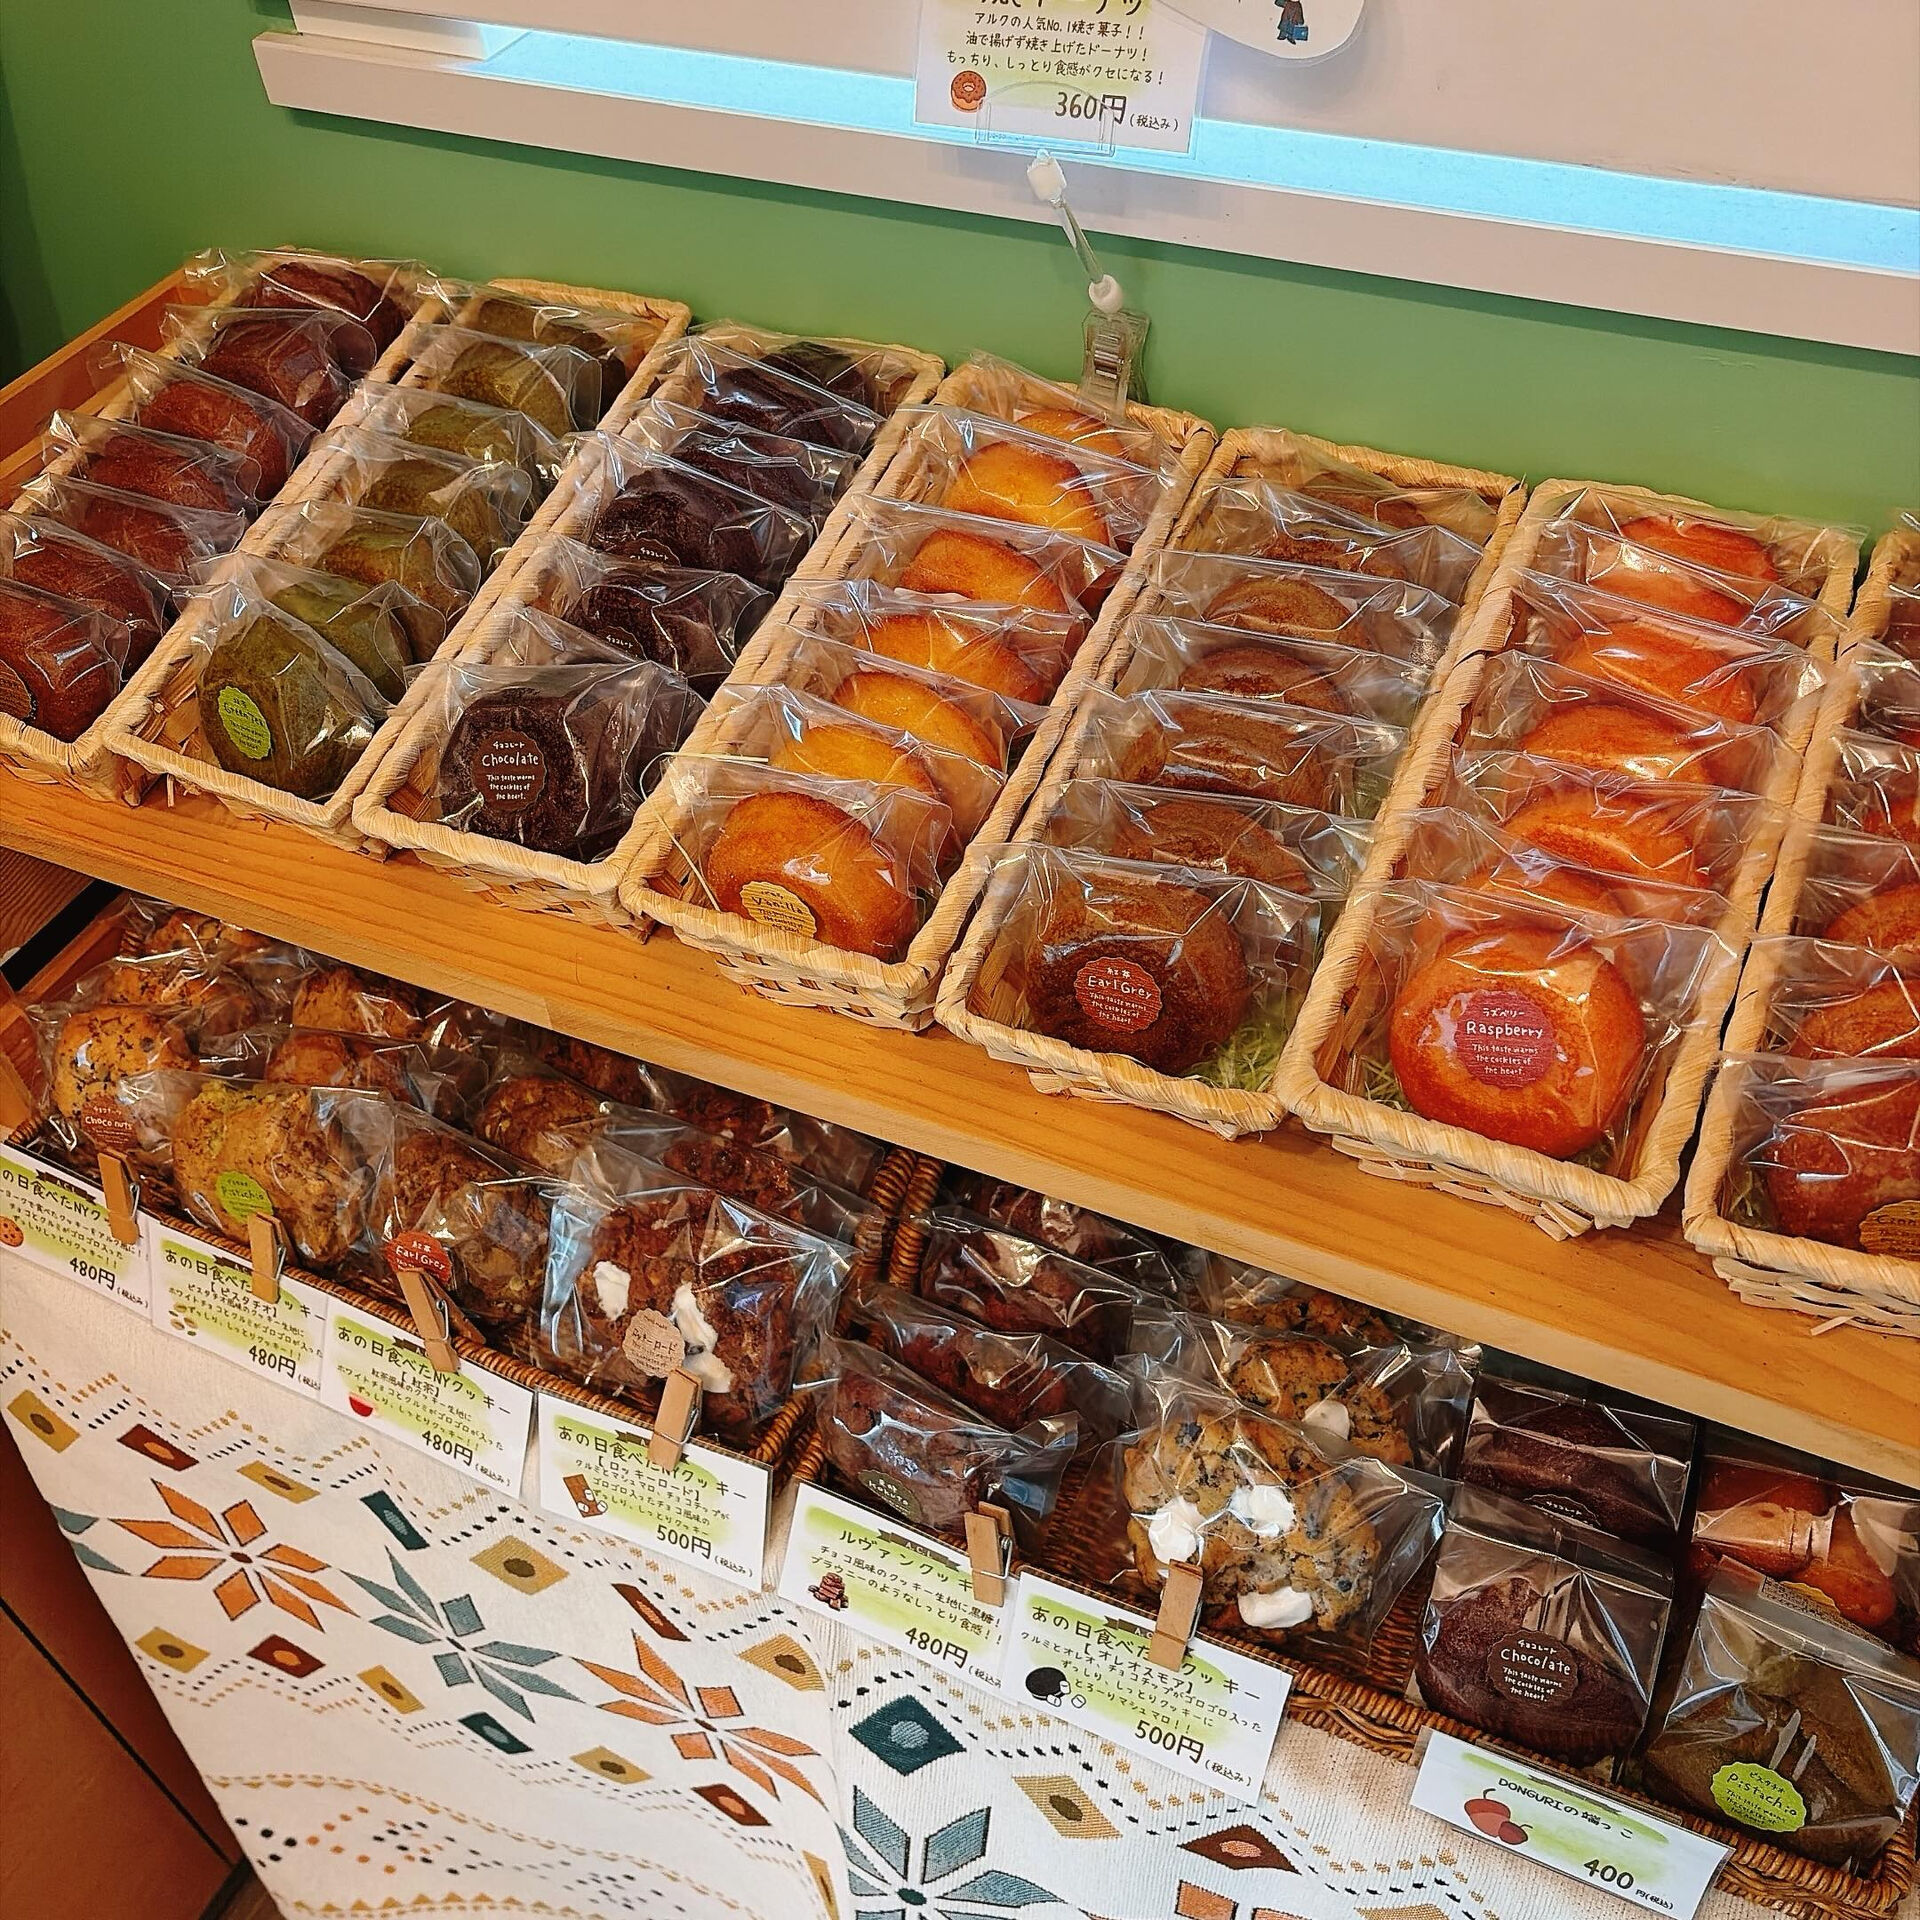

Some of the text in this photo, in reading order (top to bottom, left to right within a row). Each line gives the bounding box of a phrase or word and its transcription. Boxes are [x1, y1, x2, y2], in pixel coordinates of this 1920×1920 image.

[966, 30, 1147, 62] 油で揚げず焼き上げたドーナツ！
[947, 50, 1164, 85] もっちり、しっとり食感がクセになる！
[1055, 92, 1127, 124] 360円
[481, 752, 539, 767] Chocolate
[1087, 975, 1152, 1000] Earl Grey
[1483, 1007, 1525, 1017] ラズベリー
[1466, 1020, 1543, 1039] Raspberry
[70, 1257, 116, 1291] 480円
[249, 1345, 297, 1379] 480円
[422, 1430, 473, 1467] 480円
[656, 1524, 712, 1560] 500円
[839, 1530, 974, 1592] ルヴァンクッキ
[905, 1627, 968, 1669] 480円
[1032, 1605, 1261, 1701] あの日食べたクッキー
[1501, 1649, 1570, 1675] Chocolate
[1518, 1640, 1557, 1654] チョコレート
[1134, 1719, 1204, 1764] 500円
[1726, 1772, 1797, 1816] Pistachio
[1583, 1858, 1634, 1890] 400
